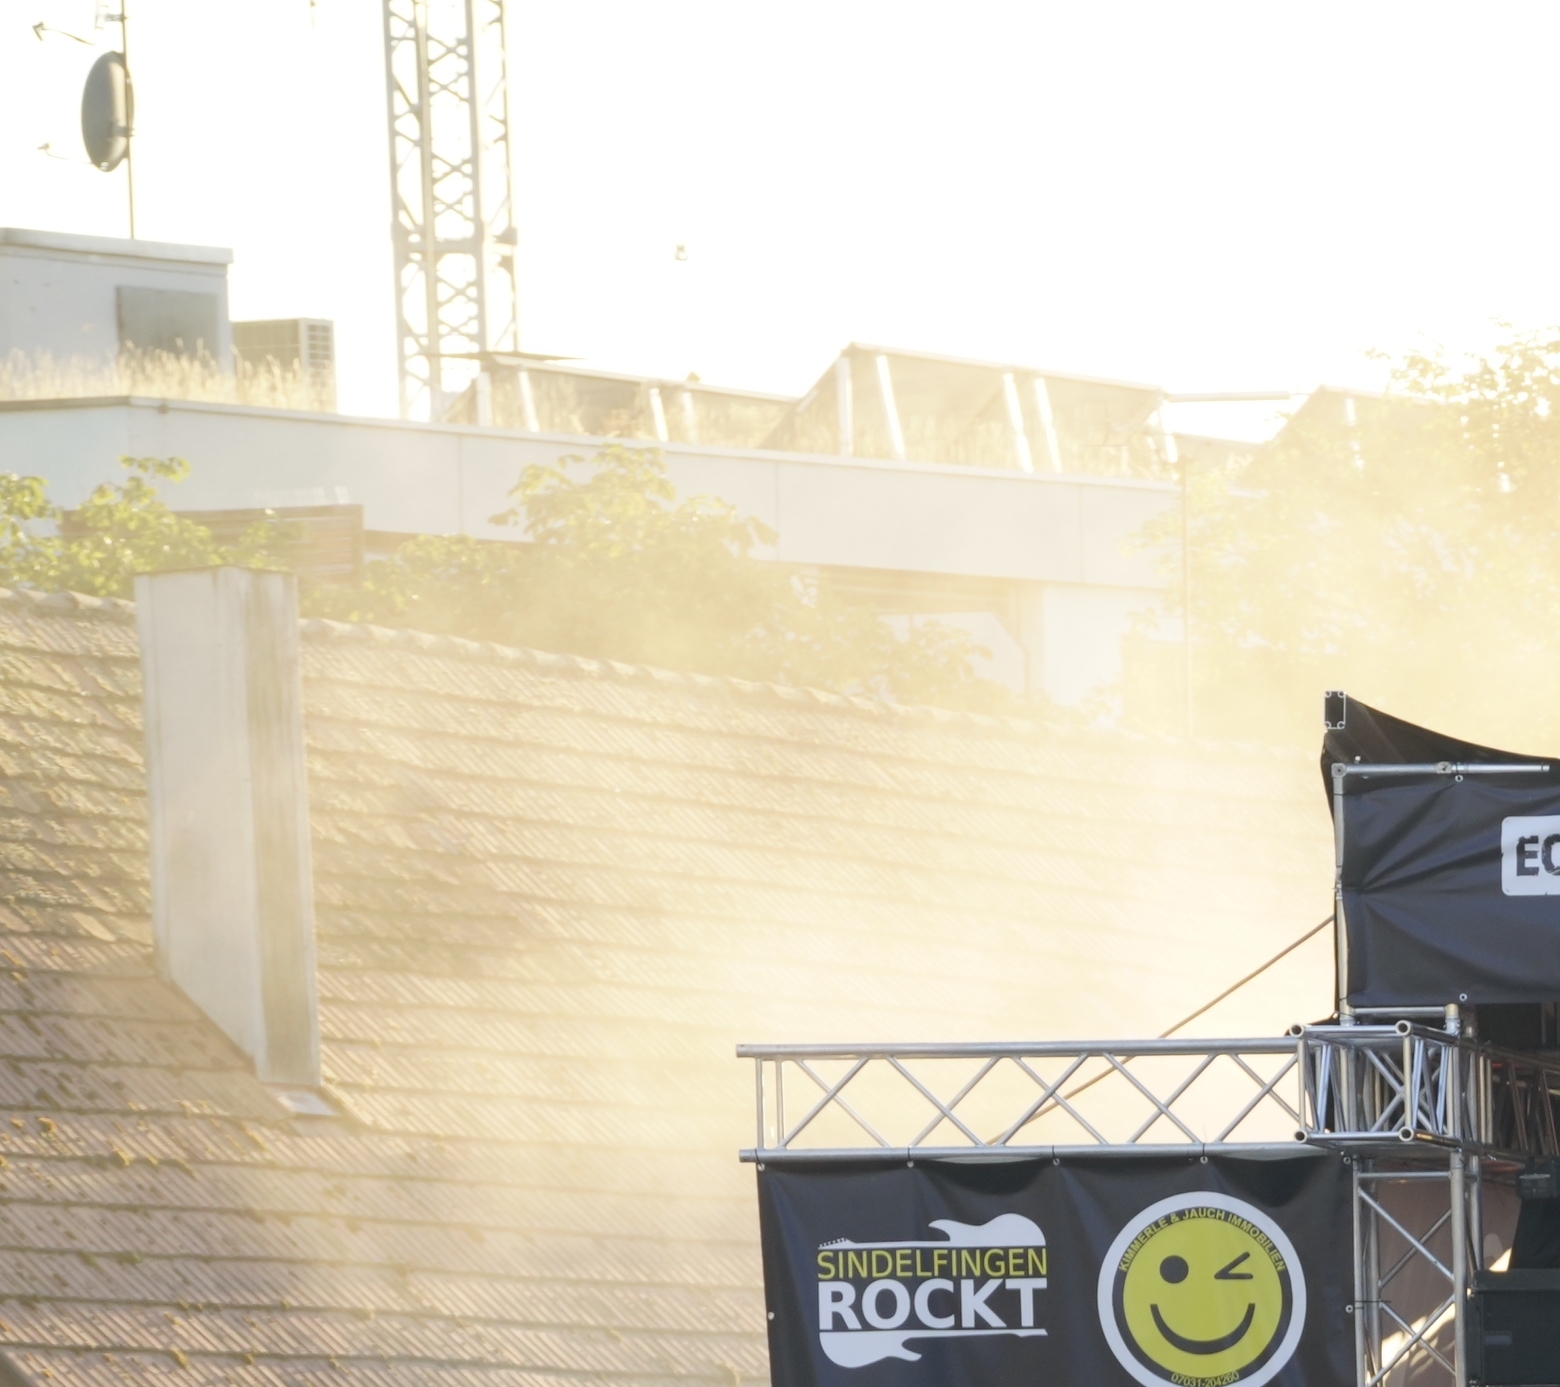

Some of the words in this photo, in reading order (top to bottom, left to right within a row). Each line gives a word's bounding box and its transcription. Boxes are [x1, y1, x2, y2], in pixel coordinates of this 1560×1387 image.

[817, 1247, 1048, 1280] SINDELFINGEN
[1118, 1218, 1169, 1272] KIMMERLE
[1170, 1213, 1180, 1223] &
[1182, 1208, 1226, 1220] JAUCH
[1227, 1214, 1285, 1271] IMMOBILIEN
[818, 1278, 1048, 1331] ROCKT
